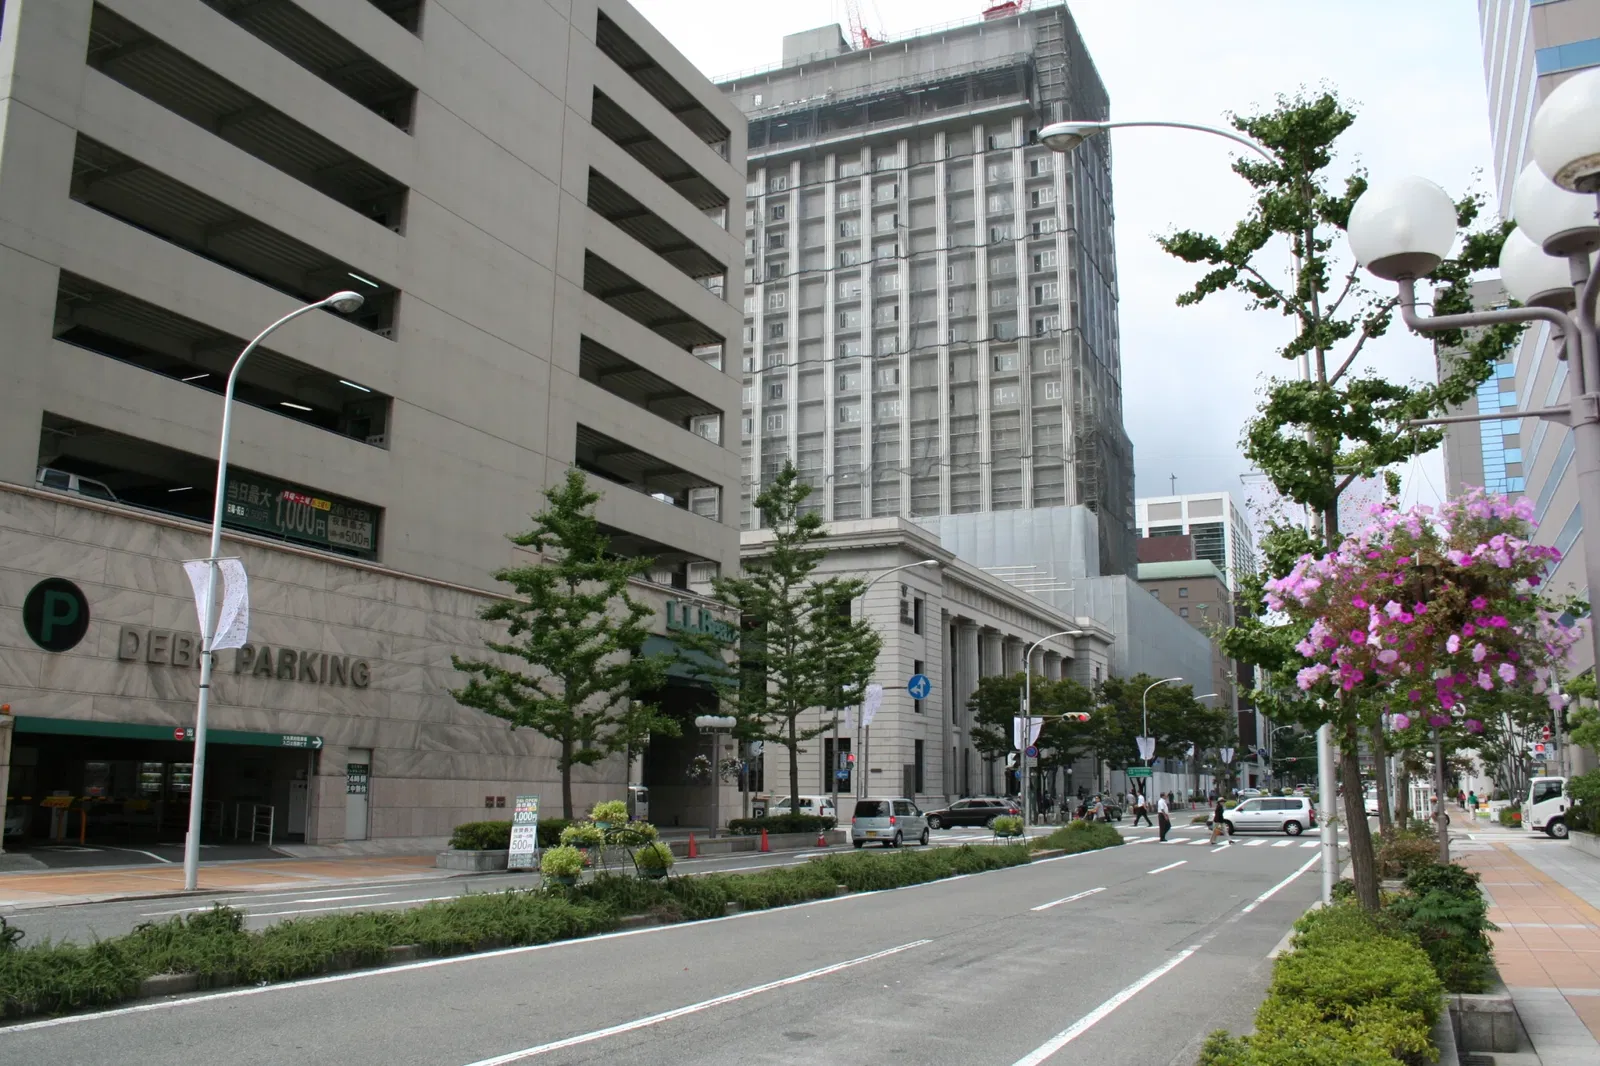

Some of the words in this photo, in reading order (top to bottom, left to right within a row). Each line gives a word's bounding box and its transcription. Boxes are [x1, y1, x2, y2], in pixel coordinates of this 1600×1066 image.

[228, 480, 272, 507] 当日最大
[275, 491, 325, 537] 1,000円
[346, 507, 370, 521] OPEN
[345, 530, 369, 547] 500円
[42, 589, 79, 642] P
[234, 643, 371, 689] PARKING
[755, 809, 764, 818] P
[511, 839, 533, 850] 500円
